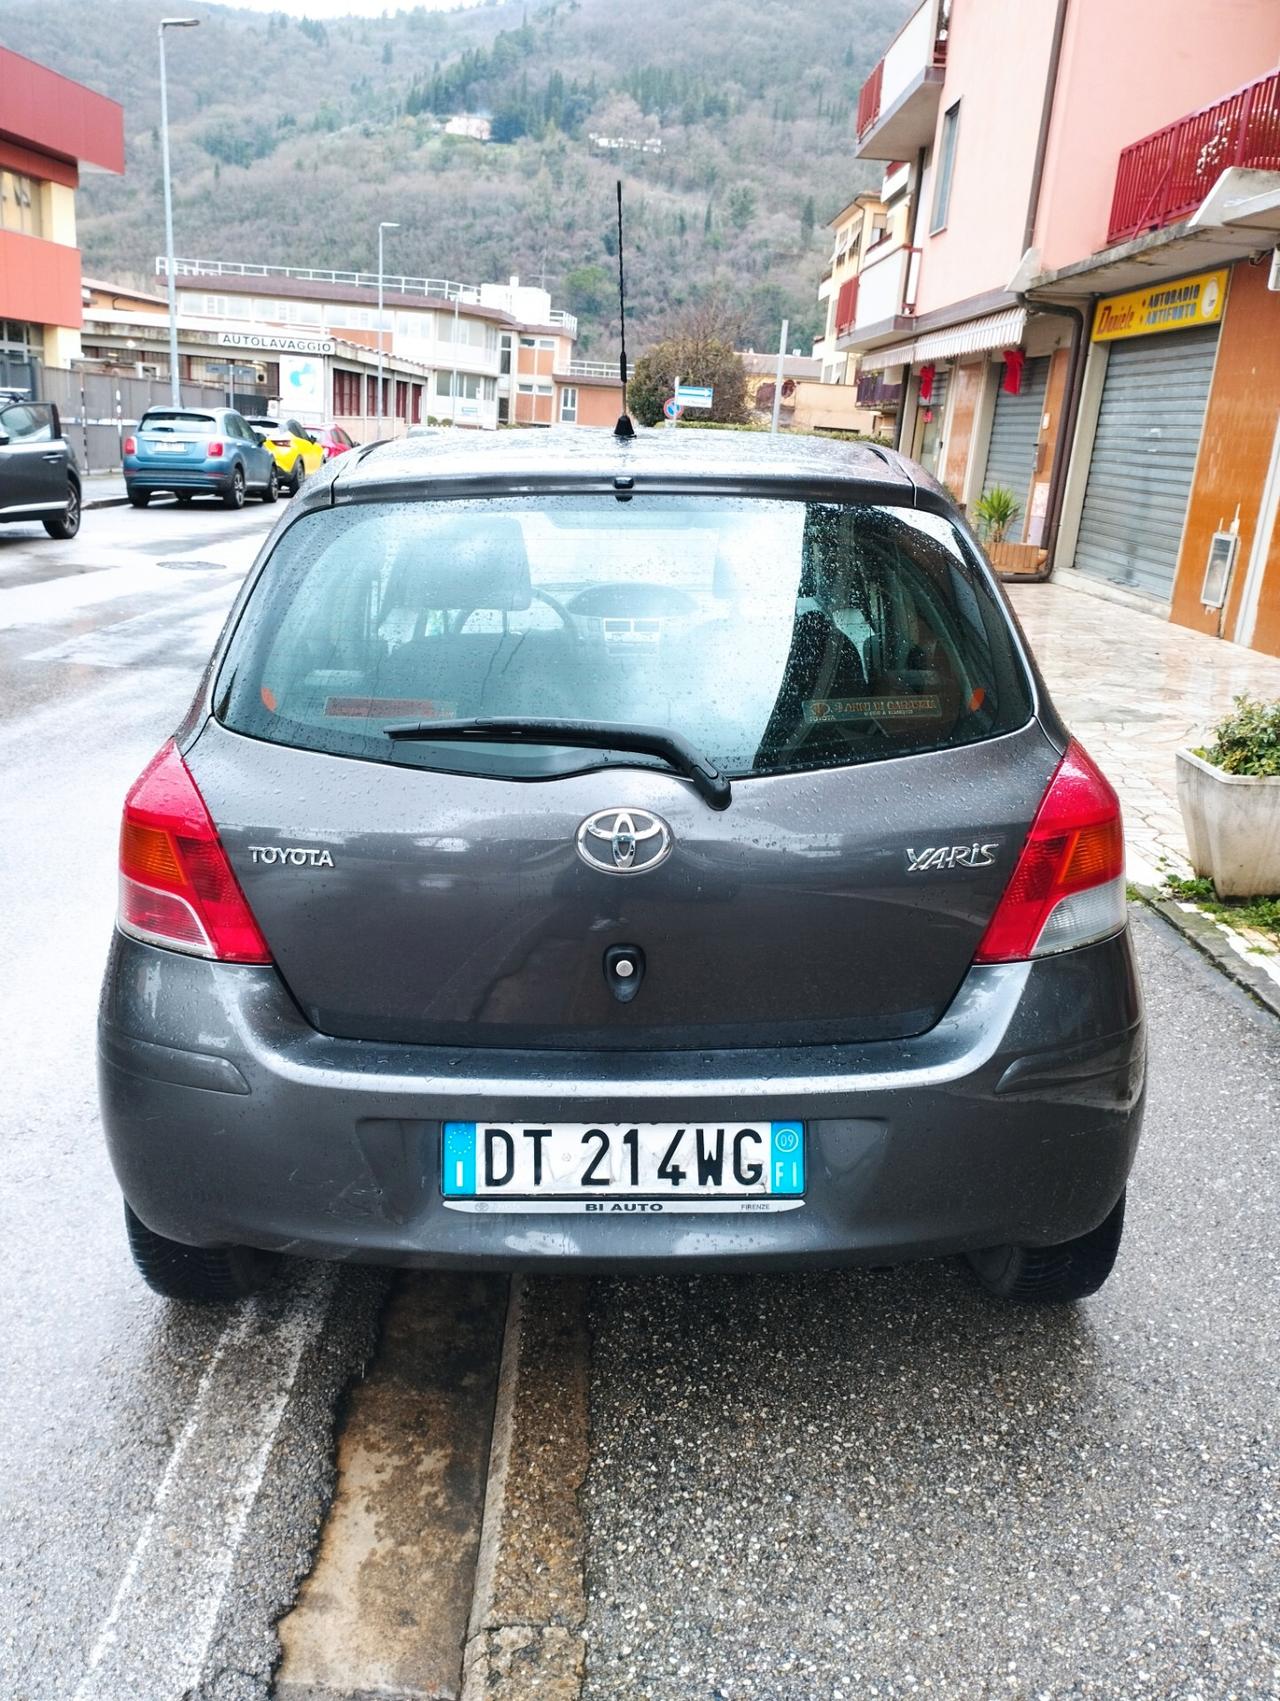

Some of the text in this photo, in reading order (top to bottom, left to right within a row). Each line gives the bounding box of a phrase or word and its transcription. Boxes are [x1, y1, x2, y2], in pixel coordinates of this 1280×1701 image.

[1148, 284, 1200, 308] AUTORADIO
[1096, 305, 1135, 335] Daniele
[222, 334, 331, 353] AUTOLAVAGGIO
[248, 846, 335, 867] TOYOTA
[780, 1133, 794, 1147] 09
[484, 1128, 764, 1187] DT 214WG
[775, 1161, 798, 1187] FI
[584, 1203, 663, 1212] BI AUTO
